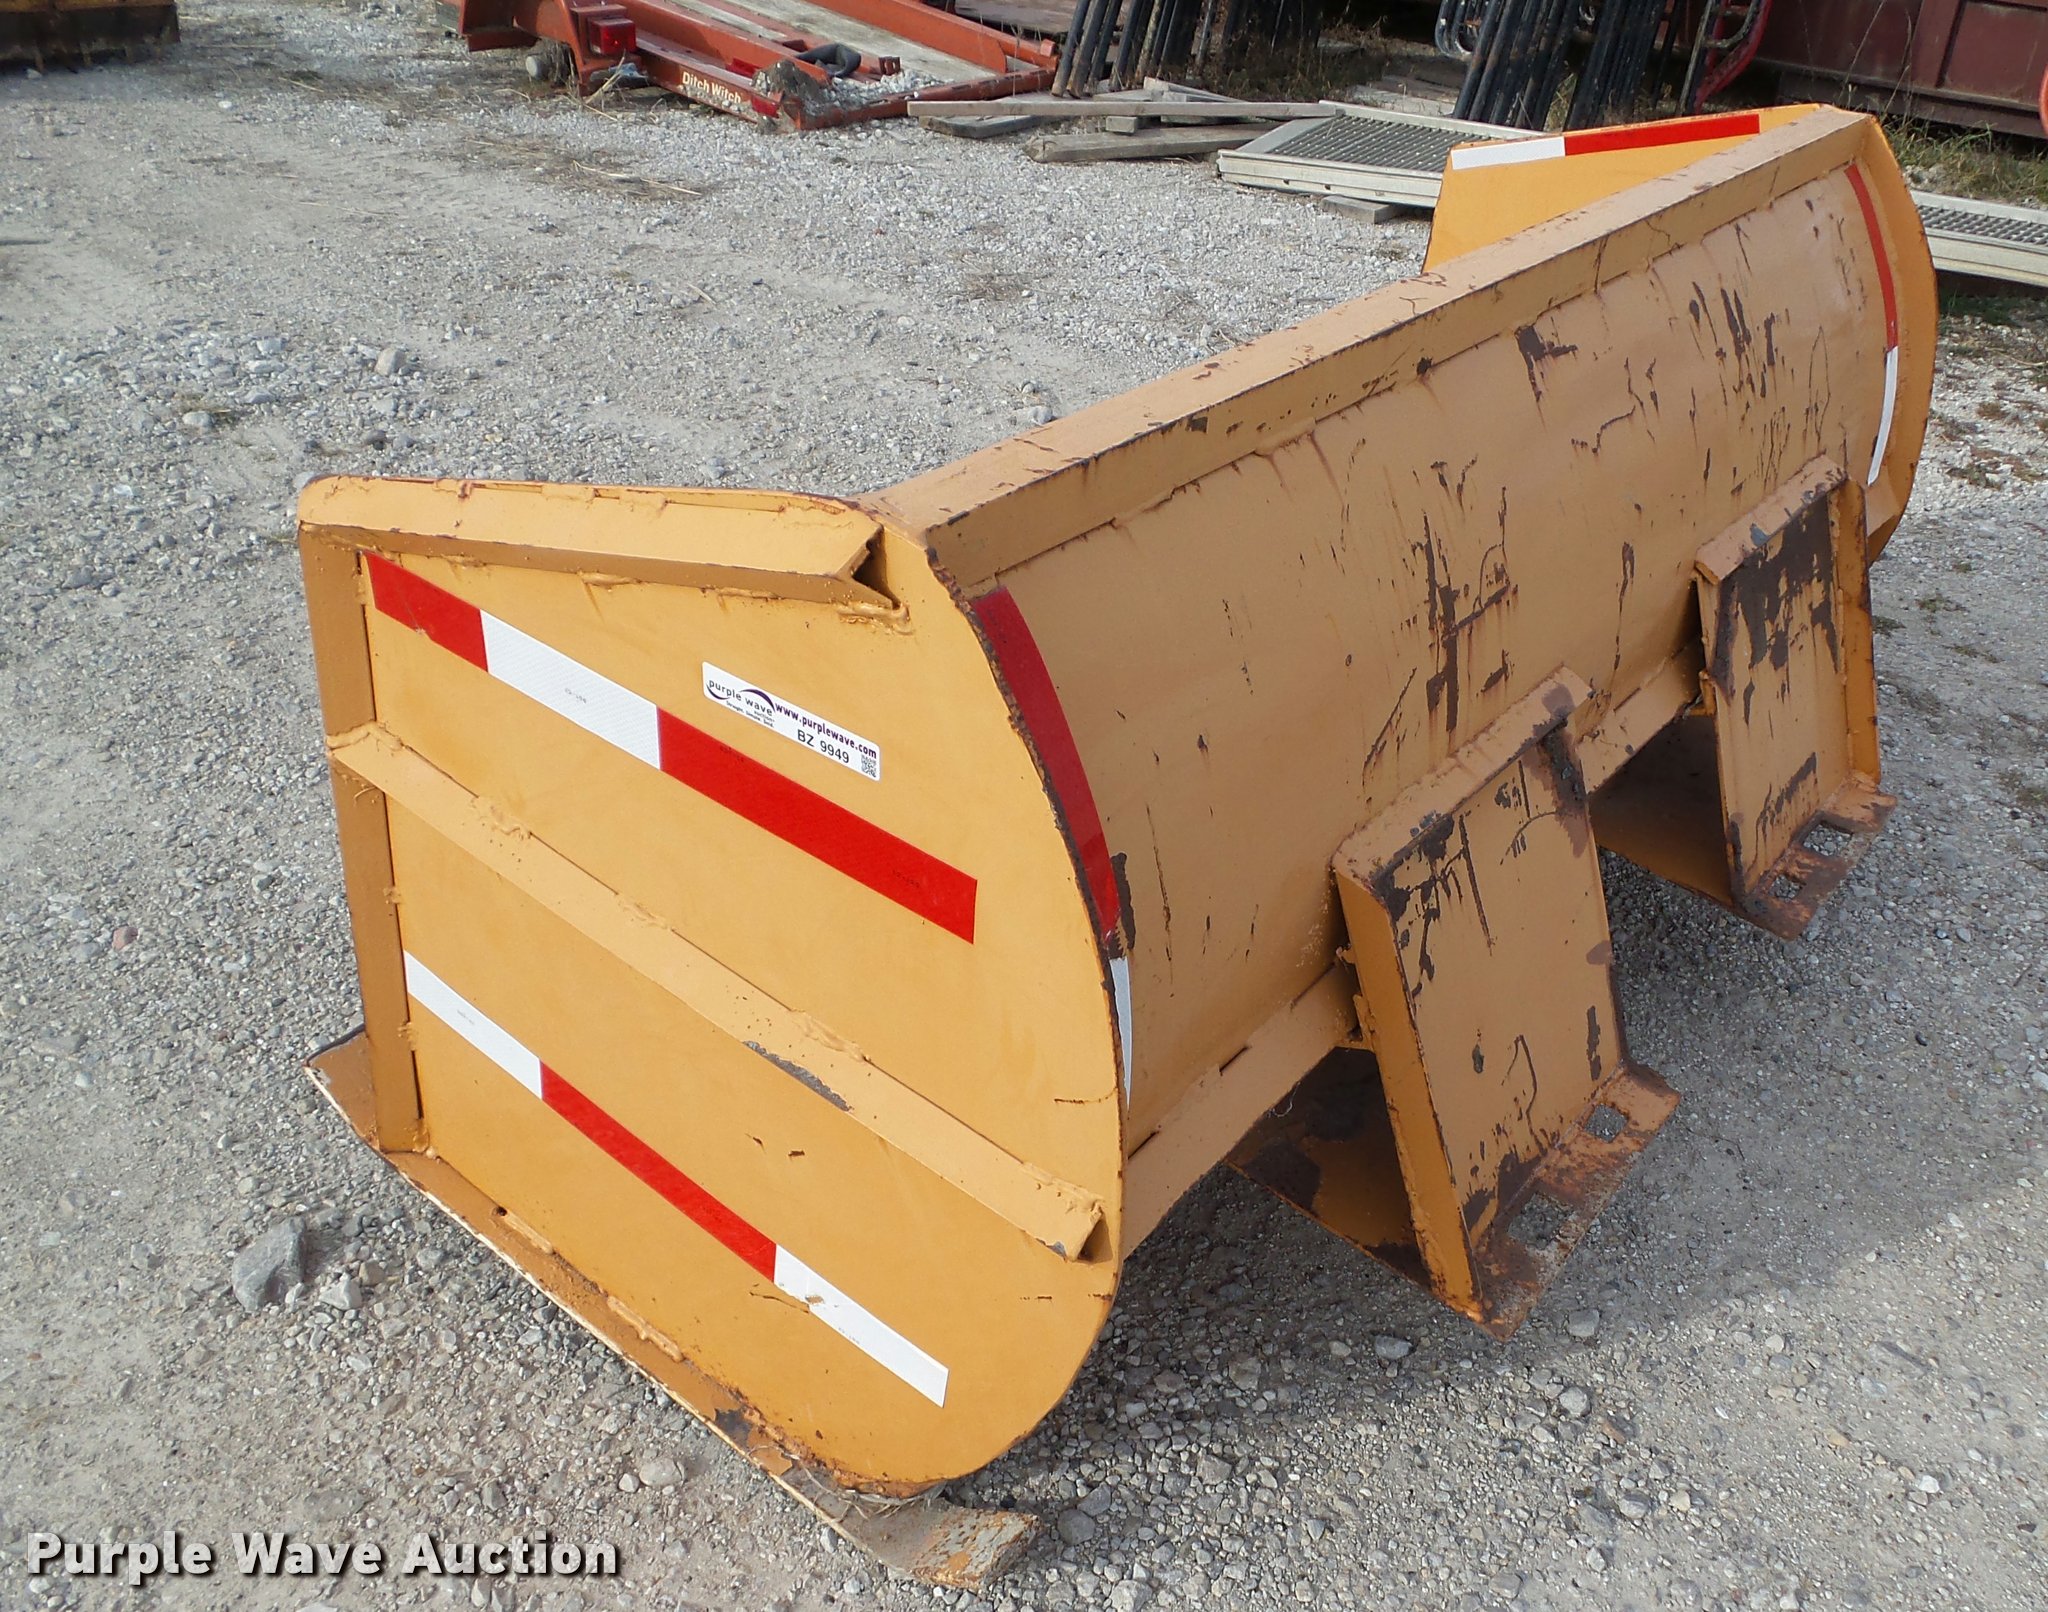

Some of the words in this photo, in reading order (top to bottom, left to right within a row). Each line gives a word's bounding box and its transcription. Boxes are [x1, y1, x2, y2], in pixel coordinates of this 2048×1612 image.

[682, 71, 710, 93] Ditch
[711, 82, 741, 103] Witch
[709, 680, 742, 701] purple
[745, 697, 773, 717] wave
[775, 702, 878, 759] www.purplewave.com
[797, 728, 815, 747] BZ
[820, 740, 850, 764] 9949
